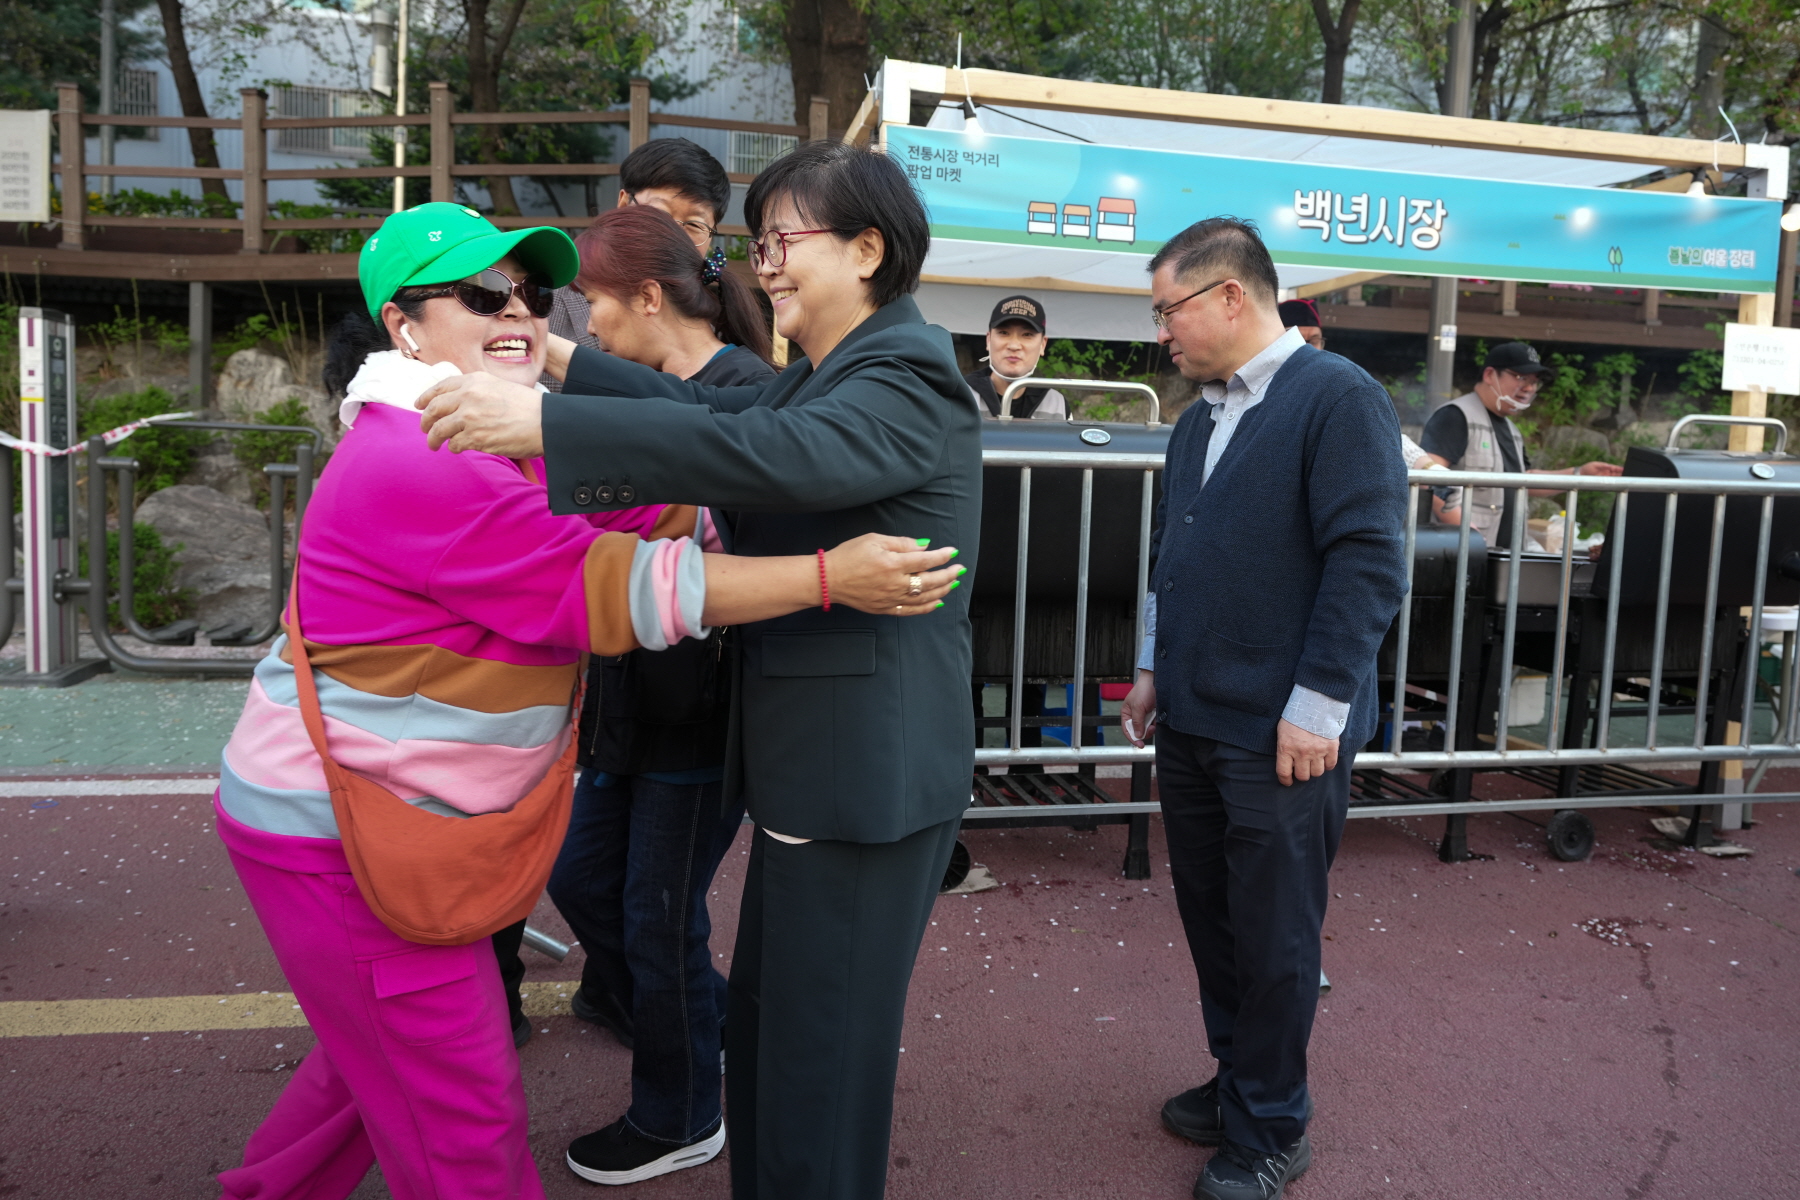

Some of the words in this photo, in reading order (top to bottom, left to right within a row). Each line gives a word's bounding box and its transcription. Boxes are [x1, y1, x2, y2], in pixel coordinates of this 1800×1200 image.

[907, 145, 959, 163] 전통시장
[962, 151, 1000, 168] 먹거리
[907, 164, 932, 180] 팝업
[936, 167, 962, 182] 마켓
[1294, 189, 1448, 250] 백년시장
